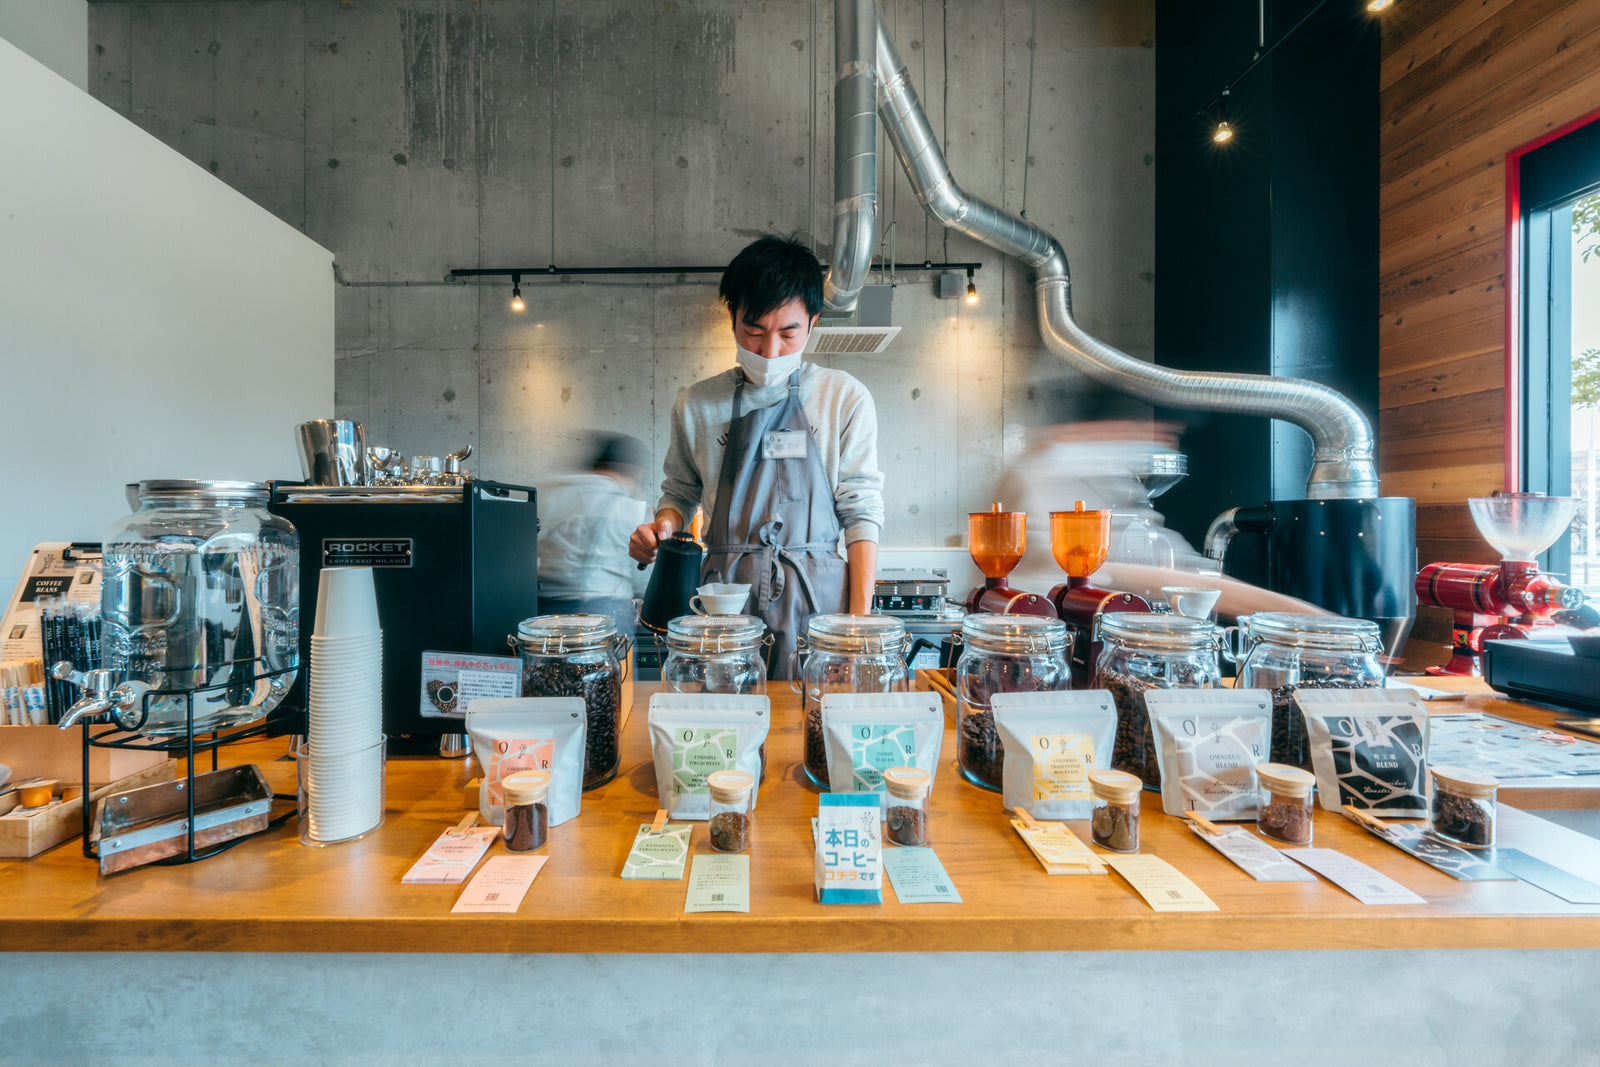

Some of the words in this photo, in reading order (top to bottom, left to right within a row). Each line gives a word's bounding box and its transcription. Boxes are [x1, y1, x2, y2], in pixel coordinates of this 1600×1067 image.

[328, 543, 405, 552] ROCKET
[861, 727, 871, 740] O
[1183, 719, 1196, 736] O
[1338, 719, 1353, 736] O
[683, 730, 693, 742] O
[498, 741, 508, 754] O
[905, 745, 912, 754] R
[1039, 737, 1050, 750] O
[1251, 743, 1260, 757] R
[1411, 743, 1422, 757] R
[726, 749, 733, 759] R
[1085, 753, 1092, 764] R
[541, 759, 549, 770] R
[825, 828, 870, 848] 本日の
[825, 851, 876, 868] コーヒー
[825, 870, 876, 882] コチラです
